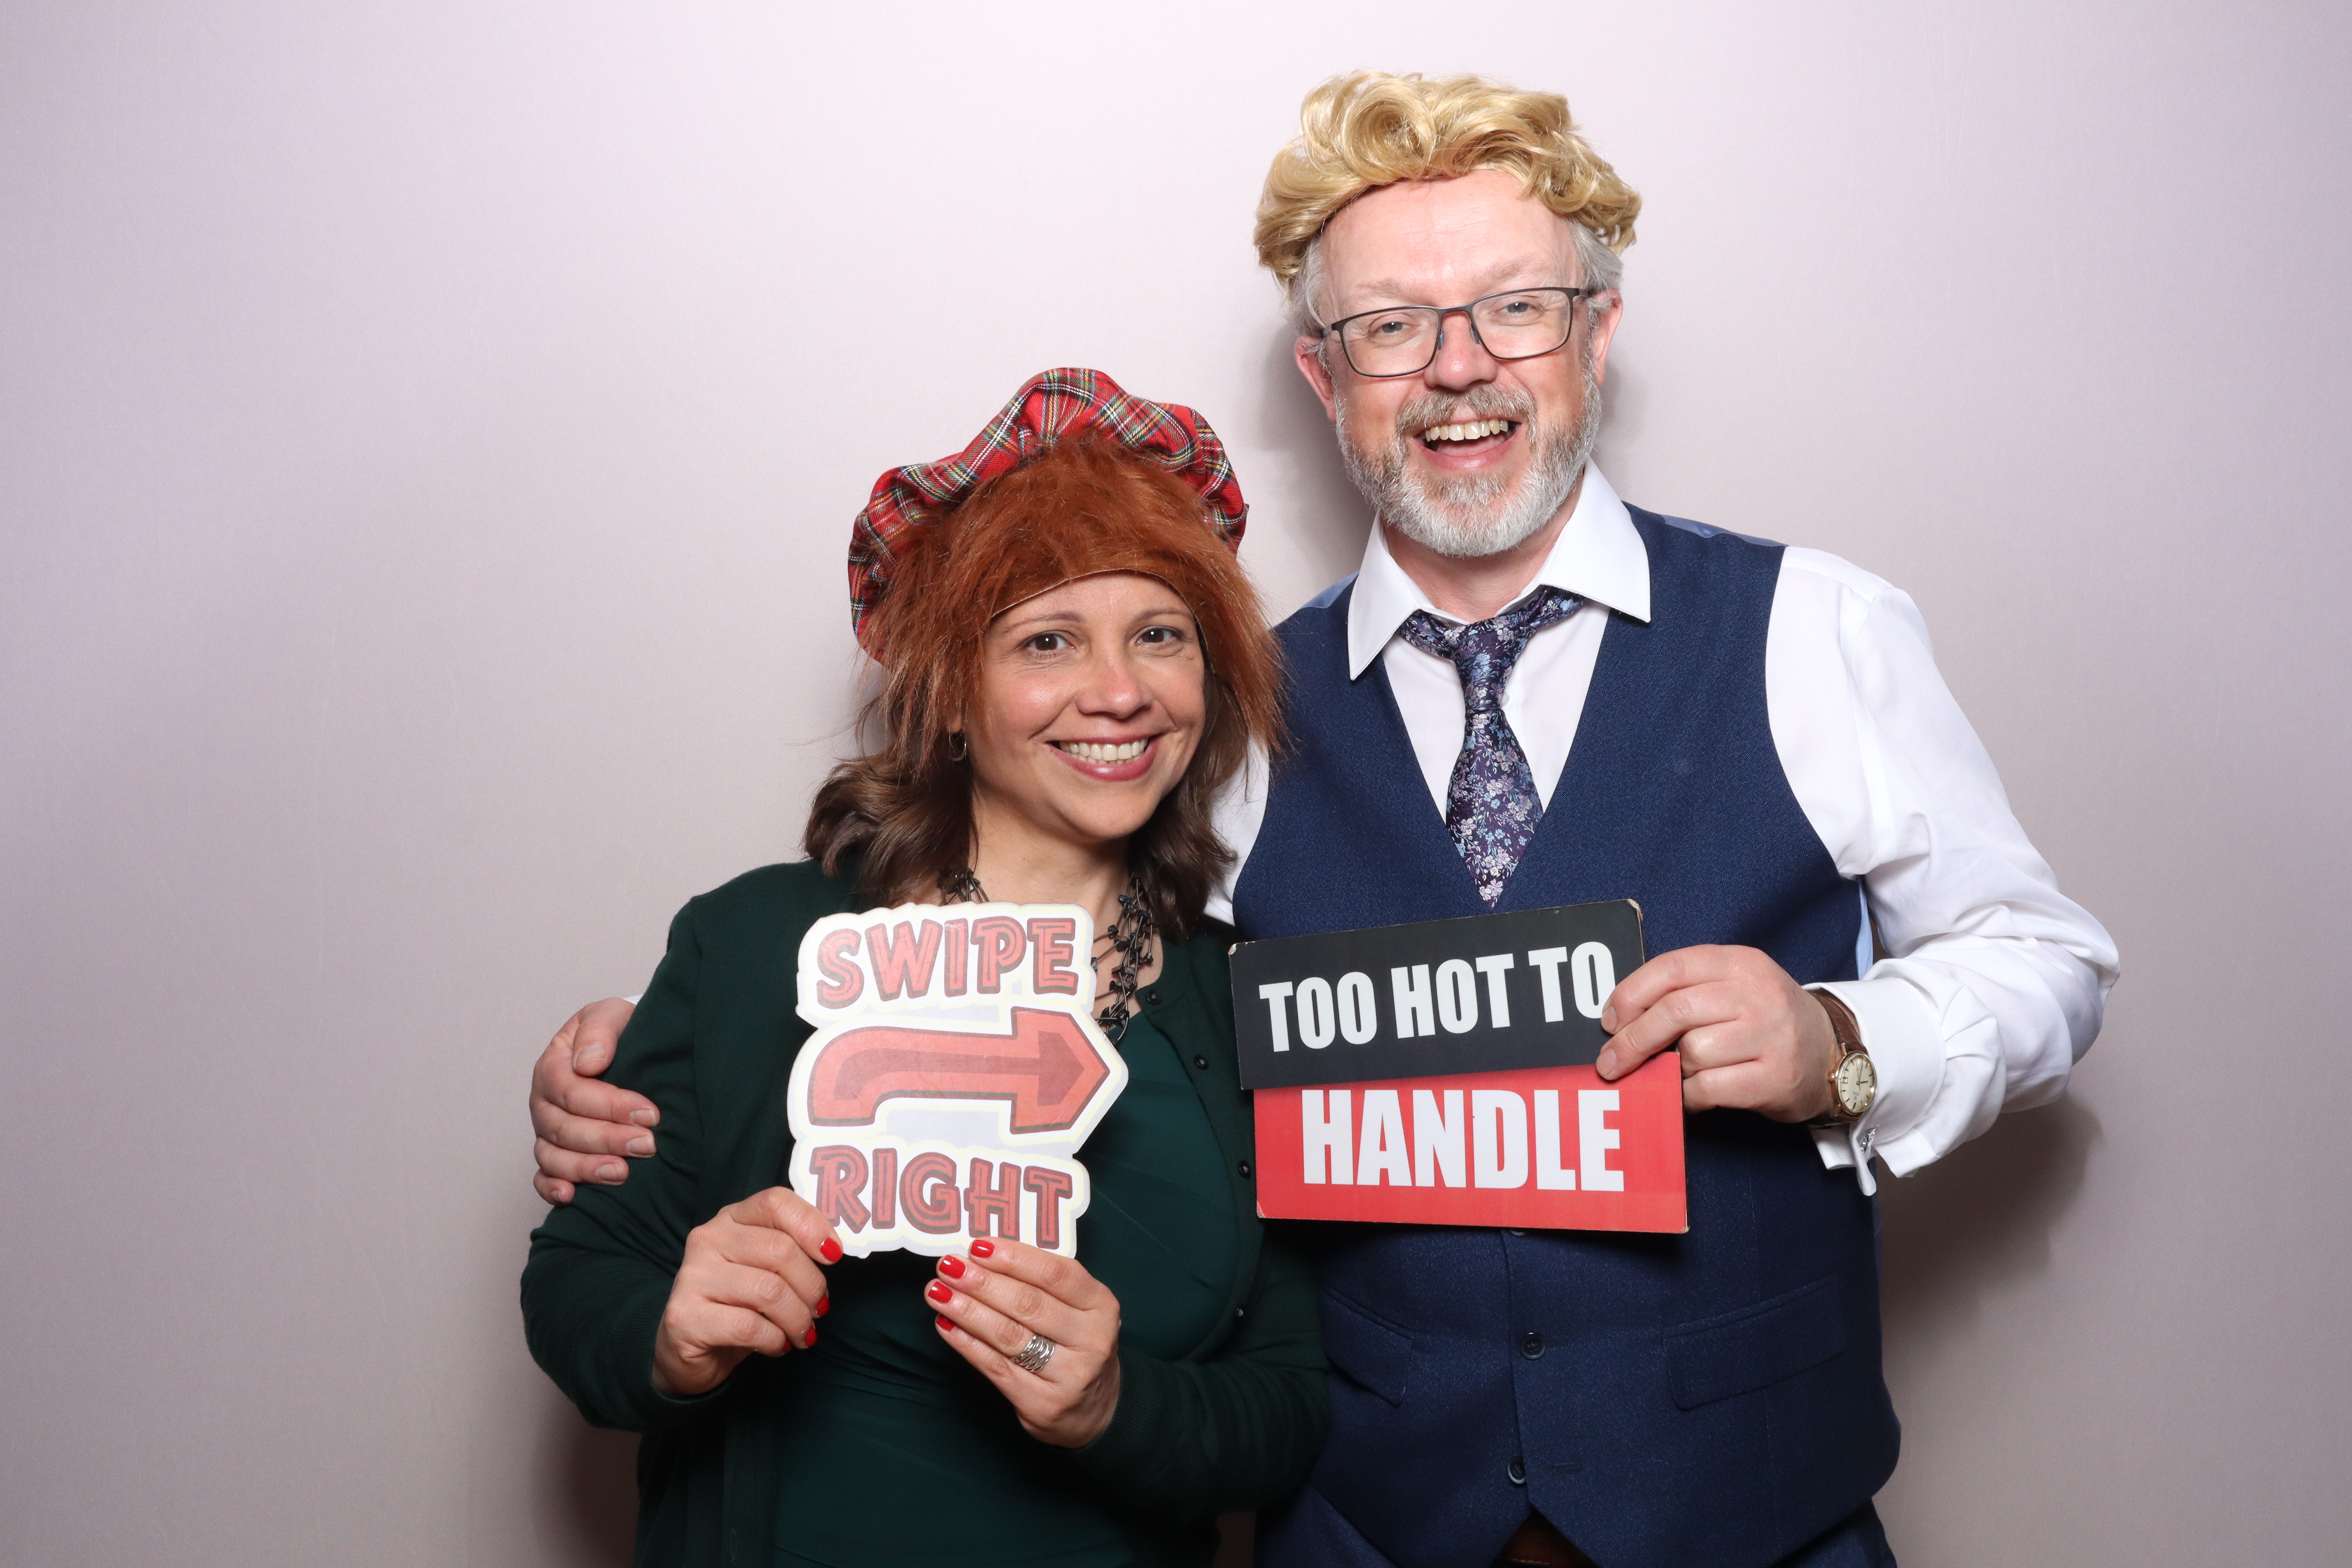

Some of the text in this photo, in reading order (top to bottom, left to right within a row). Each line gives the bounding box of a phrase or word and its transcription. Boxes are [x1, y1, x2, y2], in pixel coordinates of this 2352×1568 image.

[817, 916, 1078, 1009] SWIPE
[1259, 942, 1615, 1052] TOO HOT TO
[1302, 1089, 1624, 1192] HANDLE
[809, 1145, 1072, 1249] RIGHT
